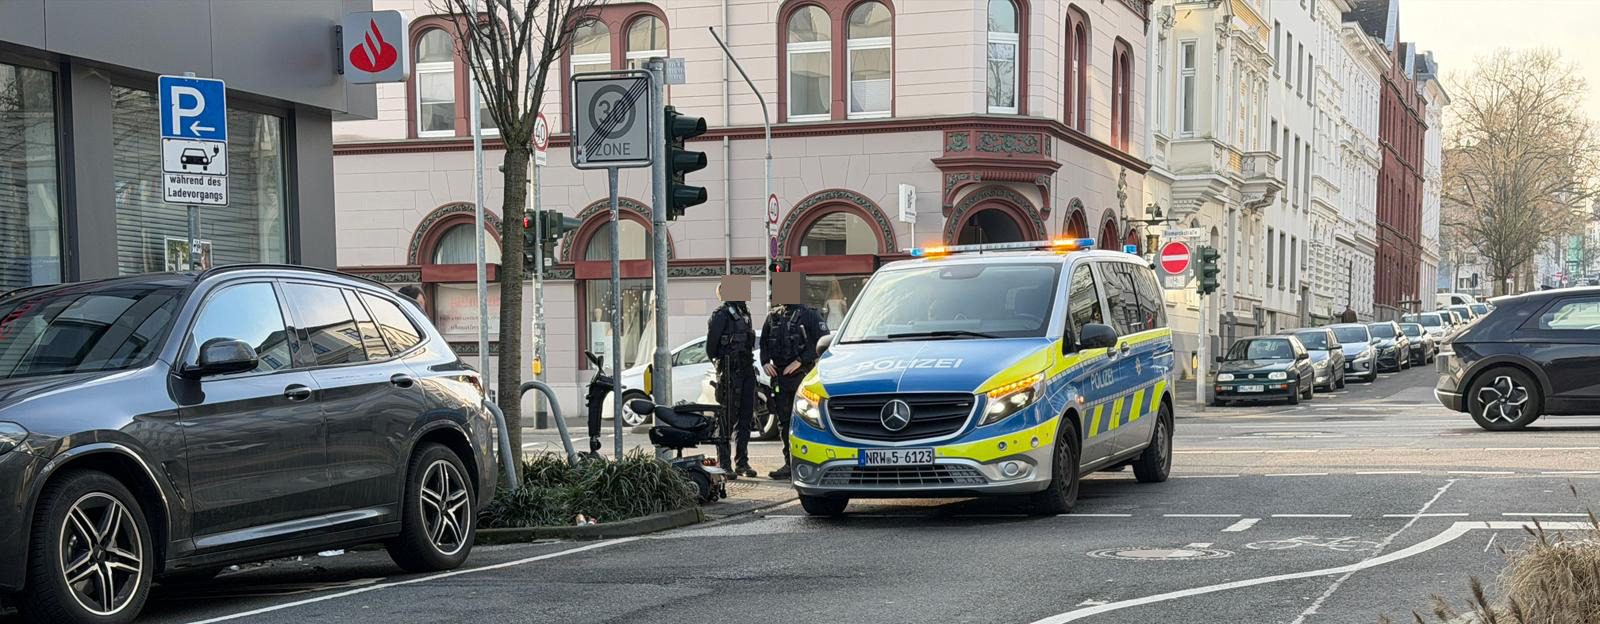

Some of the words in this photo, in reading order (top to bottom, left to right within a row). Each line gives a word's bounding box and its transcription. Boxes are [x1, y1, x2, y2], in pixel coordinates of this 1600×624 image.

[171, 86, 205, 135] P
[598, 100, 626, 124] 30
[536, 119, 545, 142] 40
[595, 142, 631, 156] ZONE
[169, 174, 204, 186] während
[207, 176, 222, 187] des
[167, 187, 224, 202] Ladevorgangs
[855, 358, 964, 372] POLIZEI
[1090, 367, 1115, 391] POLIZEI
[865, 451, 886, 465] NRW
[891, 450, 932, 464] 5-6123
